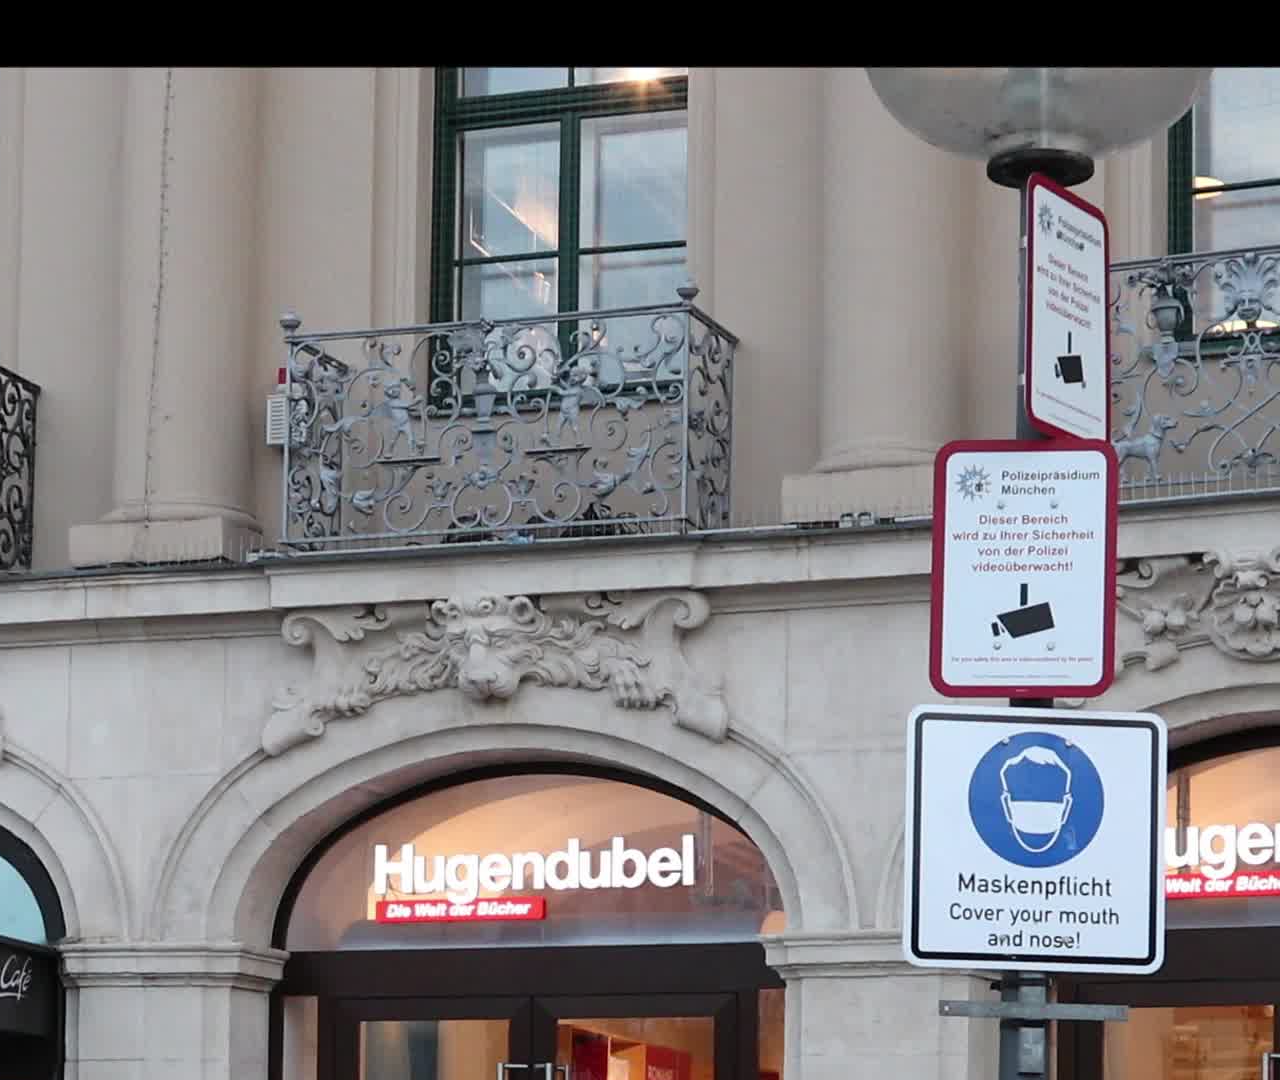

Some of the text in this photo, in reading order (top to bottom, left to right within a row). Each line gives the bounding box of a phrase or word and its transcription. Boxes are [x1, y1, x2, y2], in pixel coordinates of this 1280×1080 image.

[1001, 470, 1100, 484] Polizeipräsidium
[1001, 484, 1056, 496] München
[979, 514, 1068, 525] Dieser Bereich
[952, 530, 1094, 541] wird zu Ihrer Sicherheit
[978, 546, 1068, 557] von der Polizei
[972, 561, 1073, 572] videoüberwacht!
[374, 834, 696, 902] Hugendubel
[958, 873, 1112, 899] Maskenpflicht
[1166, 877, 1202, 893] Welt
[1204, 877, 1232, 892] der
[386, 901, 532, 918] Die Welt der Bücher
[949, 903, 1120, 925] Cover your mouth
[988, 931, 1080, 949] and nose!
